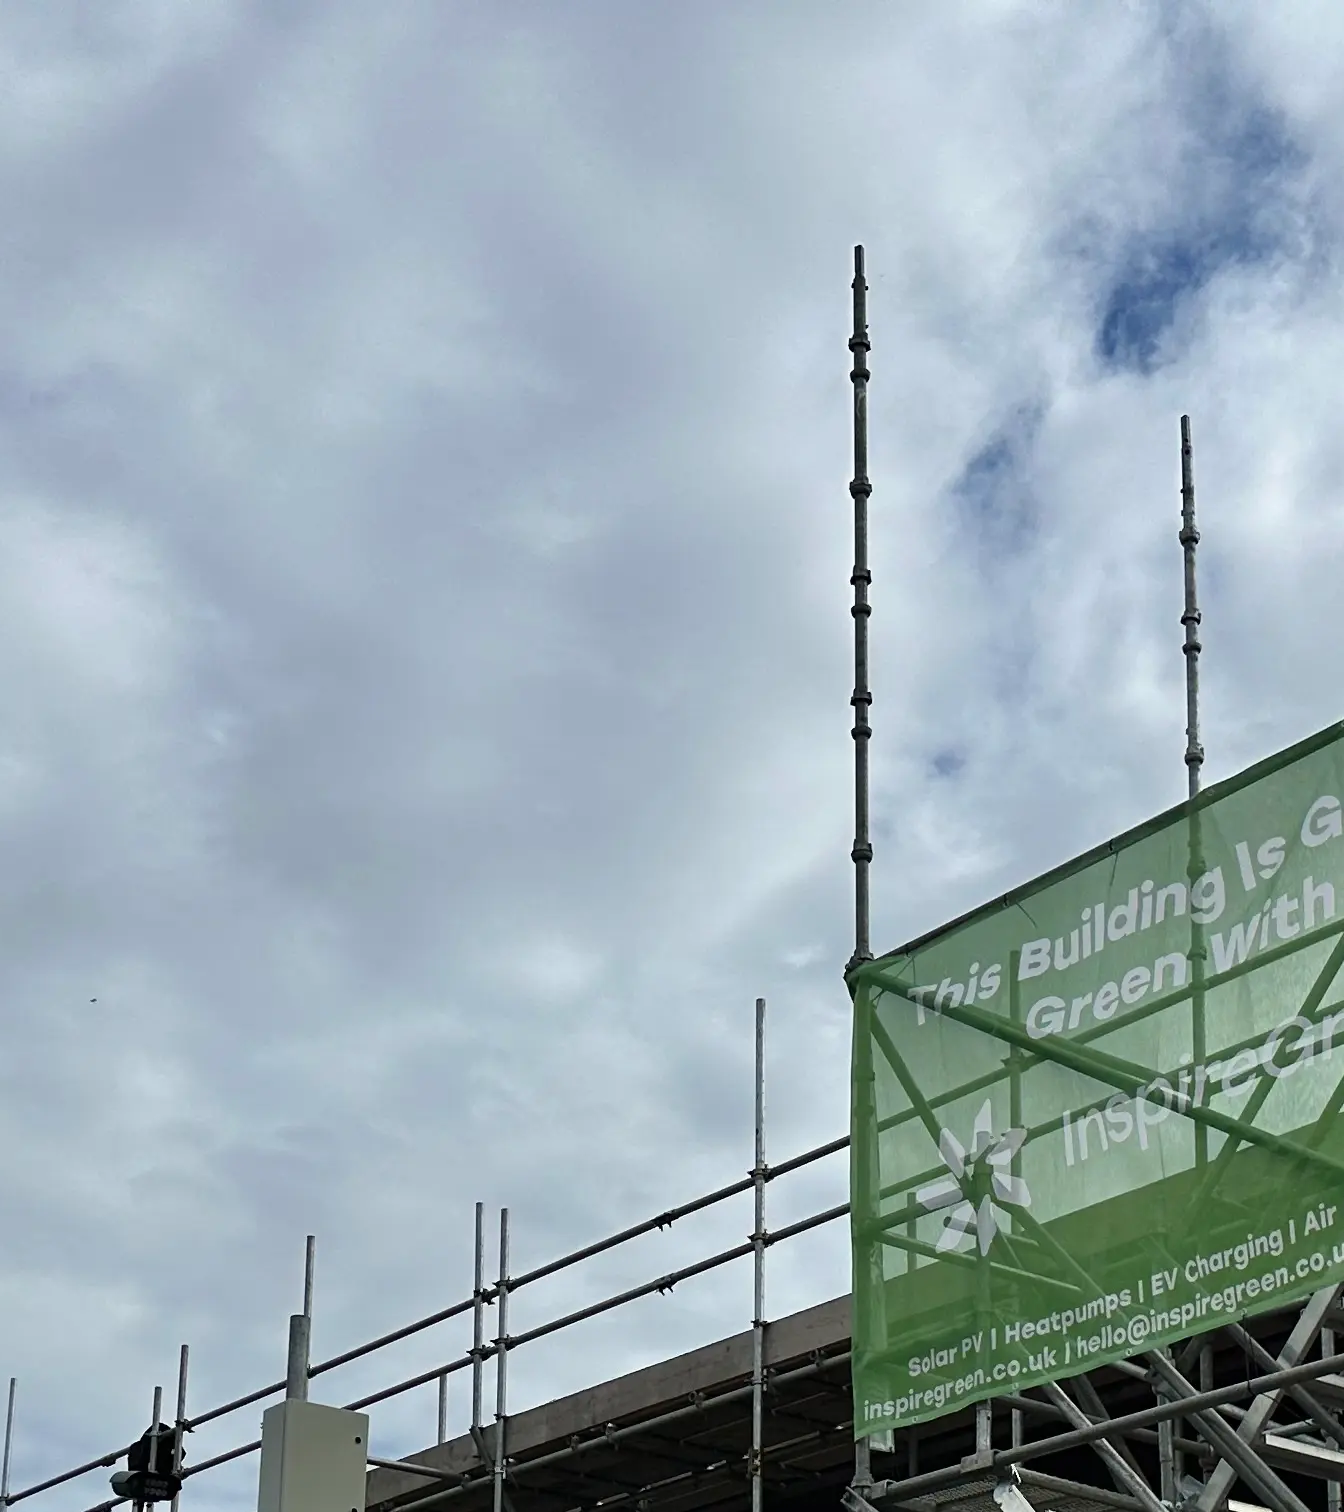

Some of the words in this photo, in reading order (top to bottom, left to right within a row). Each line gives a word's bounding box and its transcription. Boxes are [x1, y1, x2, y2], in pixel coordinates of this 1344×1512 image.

[907, 959, 1001, 1026] This
[1017, 867, 1226, 982] Building
[1235, 837, 1286, 890] Is
[1026, 950, 1189, 1040] Green
[1210, 877, 1335, 974] With
[909, 1346, 957, 1377] Solar
[962, 1331, 983, 1359] PV
[1005, 1287, 1132, 1345] Heatpumps
[1151, 1267, 1178, 1297] EV
[1184, 1231, 1283, 1282] Charging
[1304, 1202, 1338, 1237] Air
[864, 1346, 1056, 1422] inspiregreen.co.uk
